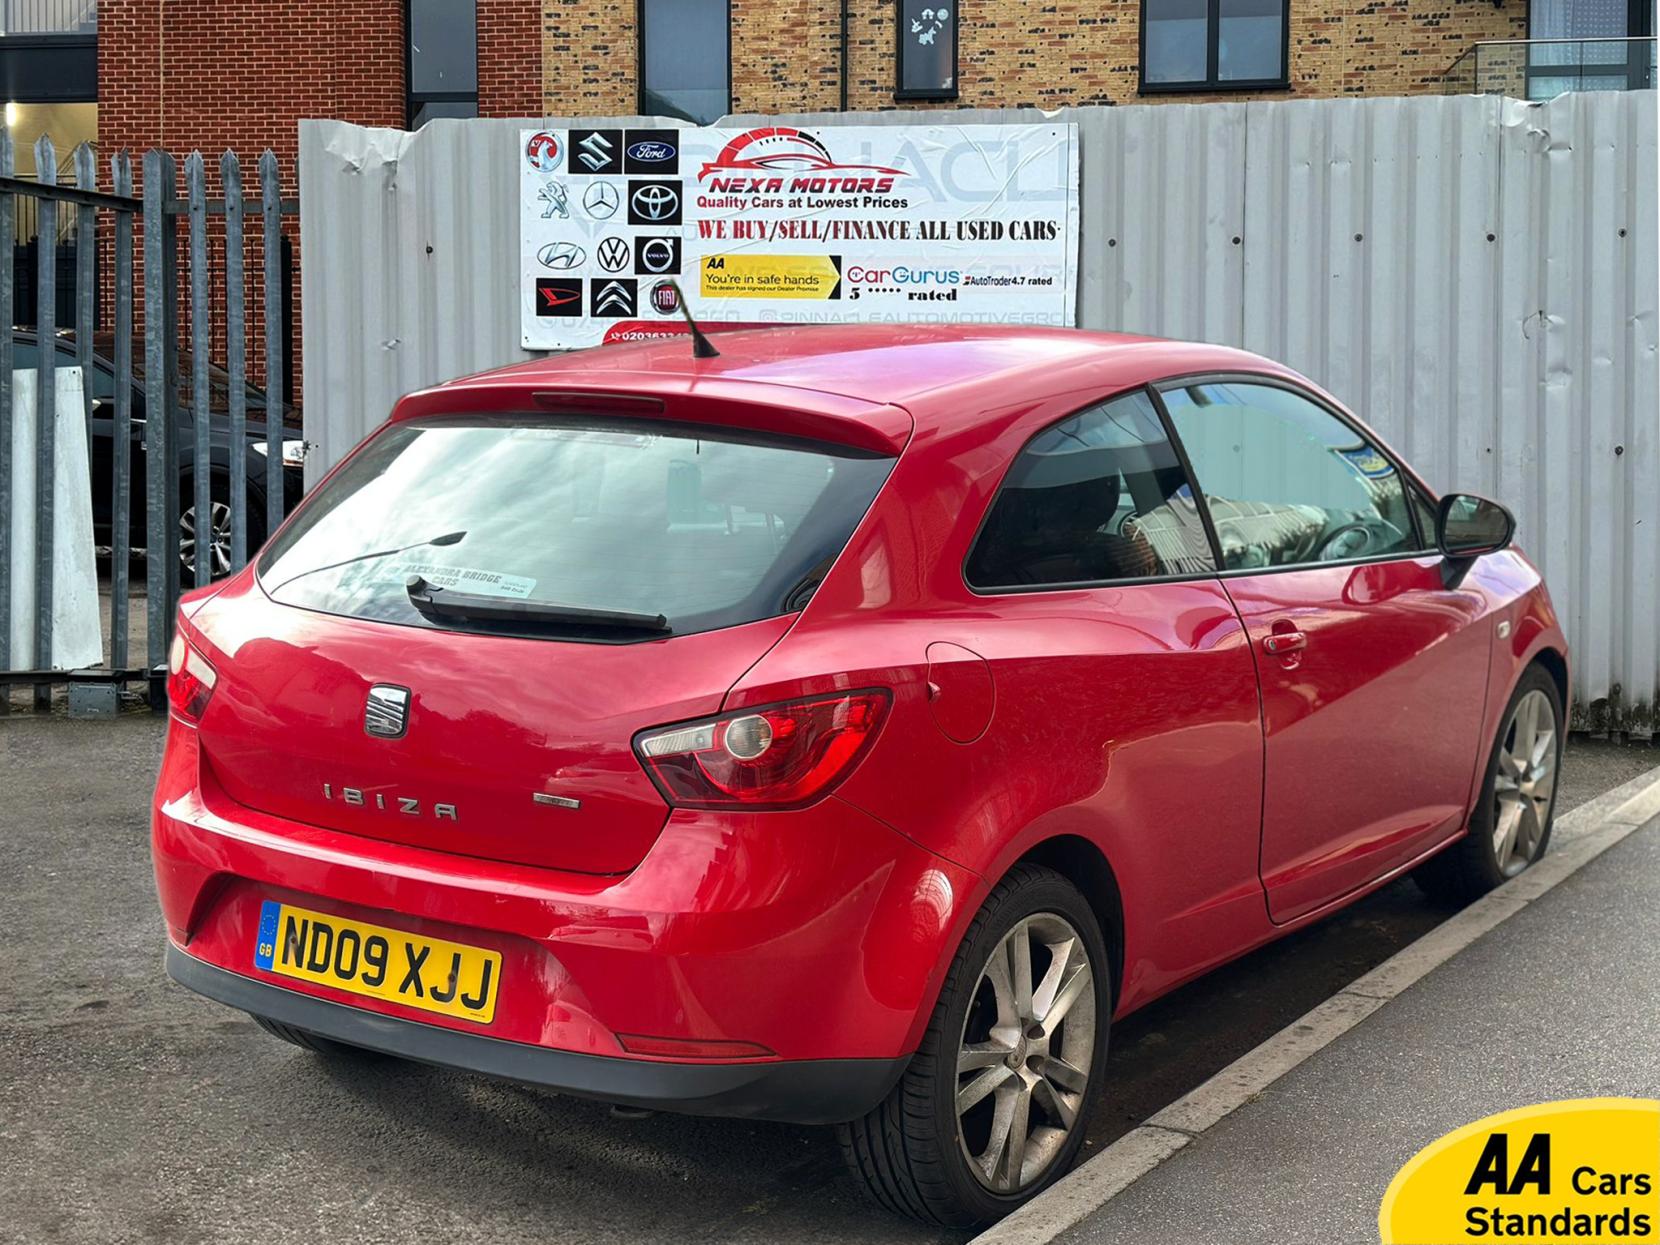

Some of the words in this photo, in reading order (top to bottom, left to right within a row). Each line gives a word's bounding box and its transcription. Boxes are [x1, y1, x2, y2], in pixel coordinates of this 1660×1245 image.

[637, 144, 666, 159] Ford
[709, 178, 784, 194] NEXA
[789, 178, 895, 194] MOTORS
[697, 196, 747, 211] Quality
[752, 196, 784, 208] Cars
[788, 196, 802, 208] at
[807, 196, 858, 208] Lowest
[863, 196, 909, 208] Prices
[697, 220, 727, 240] WE
[733, 220, 911, 243] BUY/SELL/FINANCE
[916, 220, 951, 240] ALL
[956, 220, 1004, 240] USED
[706, 257, 725, 269] AA
[705, 273, 741, 284] You're
[744, 273, 755, 284] in
[757, 273, 781, 285] safe
[784, 274, 820, 286] hands
[847, 265, 960, 284] CarGurus
[1028, 276, 1053, 286] rated
[658, 290, 675, 305] FIAT
[849, 287, 860, 301] 5
[908, 288, 957, 301] rated
[462, 569, 502, 585] BRIDGE
[323, 783, 457, 820] IBIZA
[259, 942, 273, 957] GB
[282, 915, 389, 987] ND09
[398, 942, 493, 1010] XJJ
